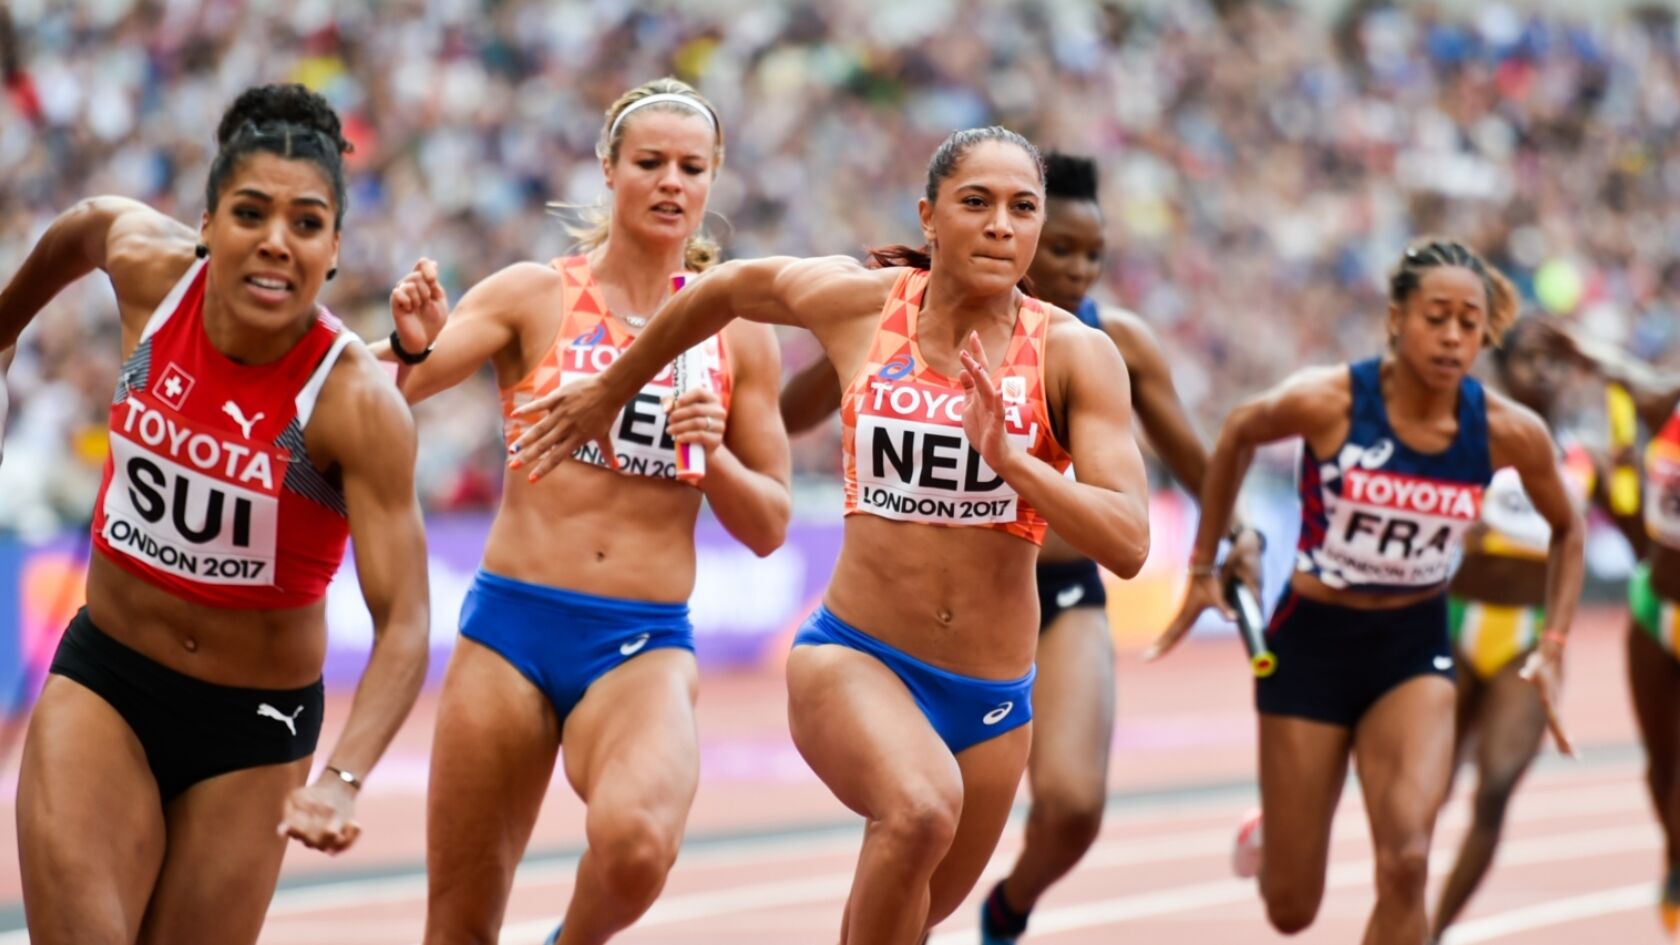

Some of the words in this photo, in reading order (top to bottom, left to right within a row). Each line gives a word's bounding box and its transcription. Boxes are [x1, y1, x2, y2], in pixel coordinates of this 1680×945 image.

[871, 381, 1023, 430] TOYOA
[124, 396, 274, 490] TOYOTA
[652, 460, 677, 480] 20
[127, 457, 252, 548] SUI
[864, 487, 955, 518] LONDON
[960, 499, 1012, 519] 2017
[1350, 471, 1476, 519] TOYOTA
[105, 514, 197, 574] ONDON
[203, 557, 266, 579] 2017
[1343, 511, 1452, 559] FRA
